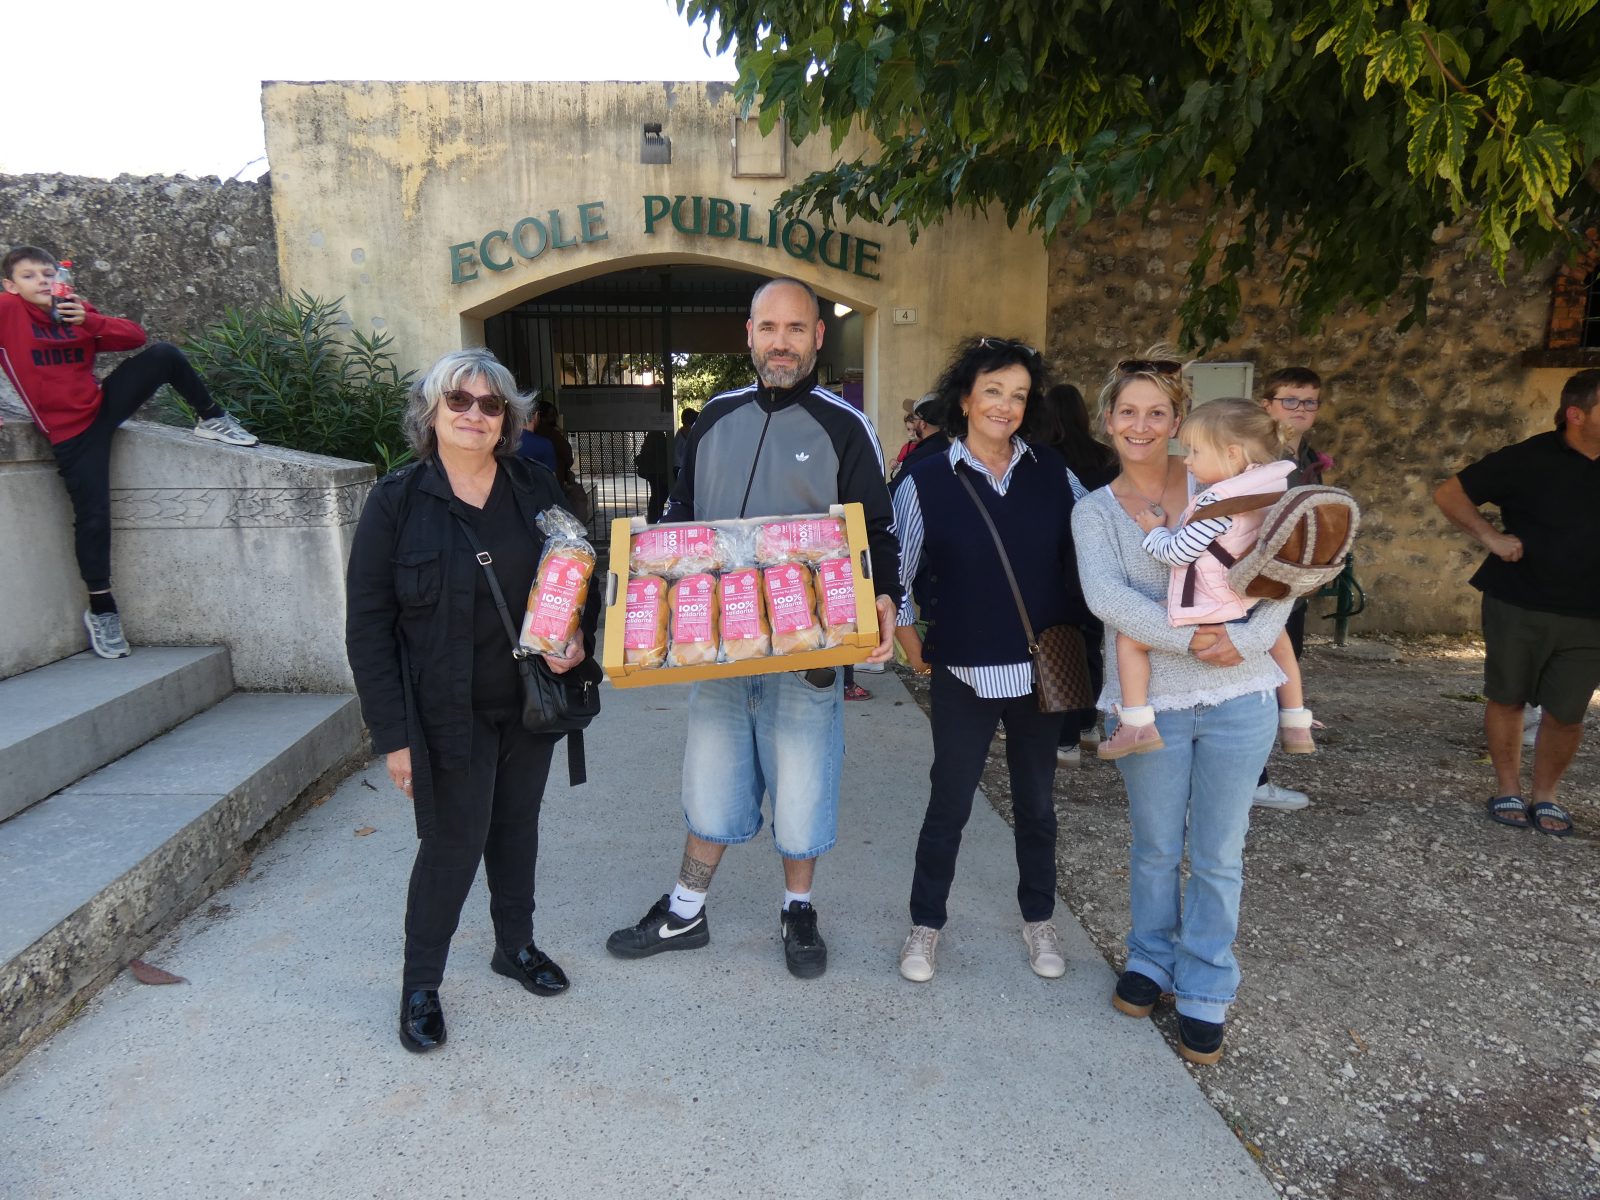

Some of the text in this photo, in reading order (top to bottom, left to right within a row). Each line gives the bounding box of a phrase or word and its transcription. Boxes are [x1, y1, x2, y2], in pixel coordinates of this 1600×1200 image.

[449, 195, 881, 285] ECOLE PUBLIQUE
[902, 311, 908, 320] 4
[31, 348, 84, 366] RIDER
[669, 531, 677, 553] 100%
[827, 586, 854, 596] 100%
[542, 593, 571, 608] 100%
[773, 592, 802, 605] 100%
[679, 604, 707, 612] 100%
[726, 600, 754, 611] 100%
